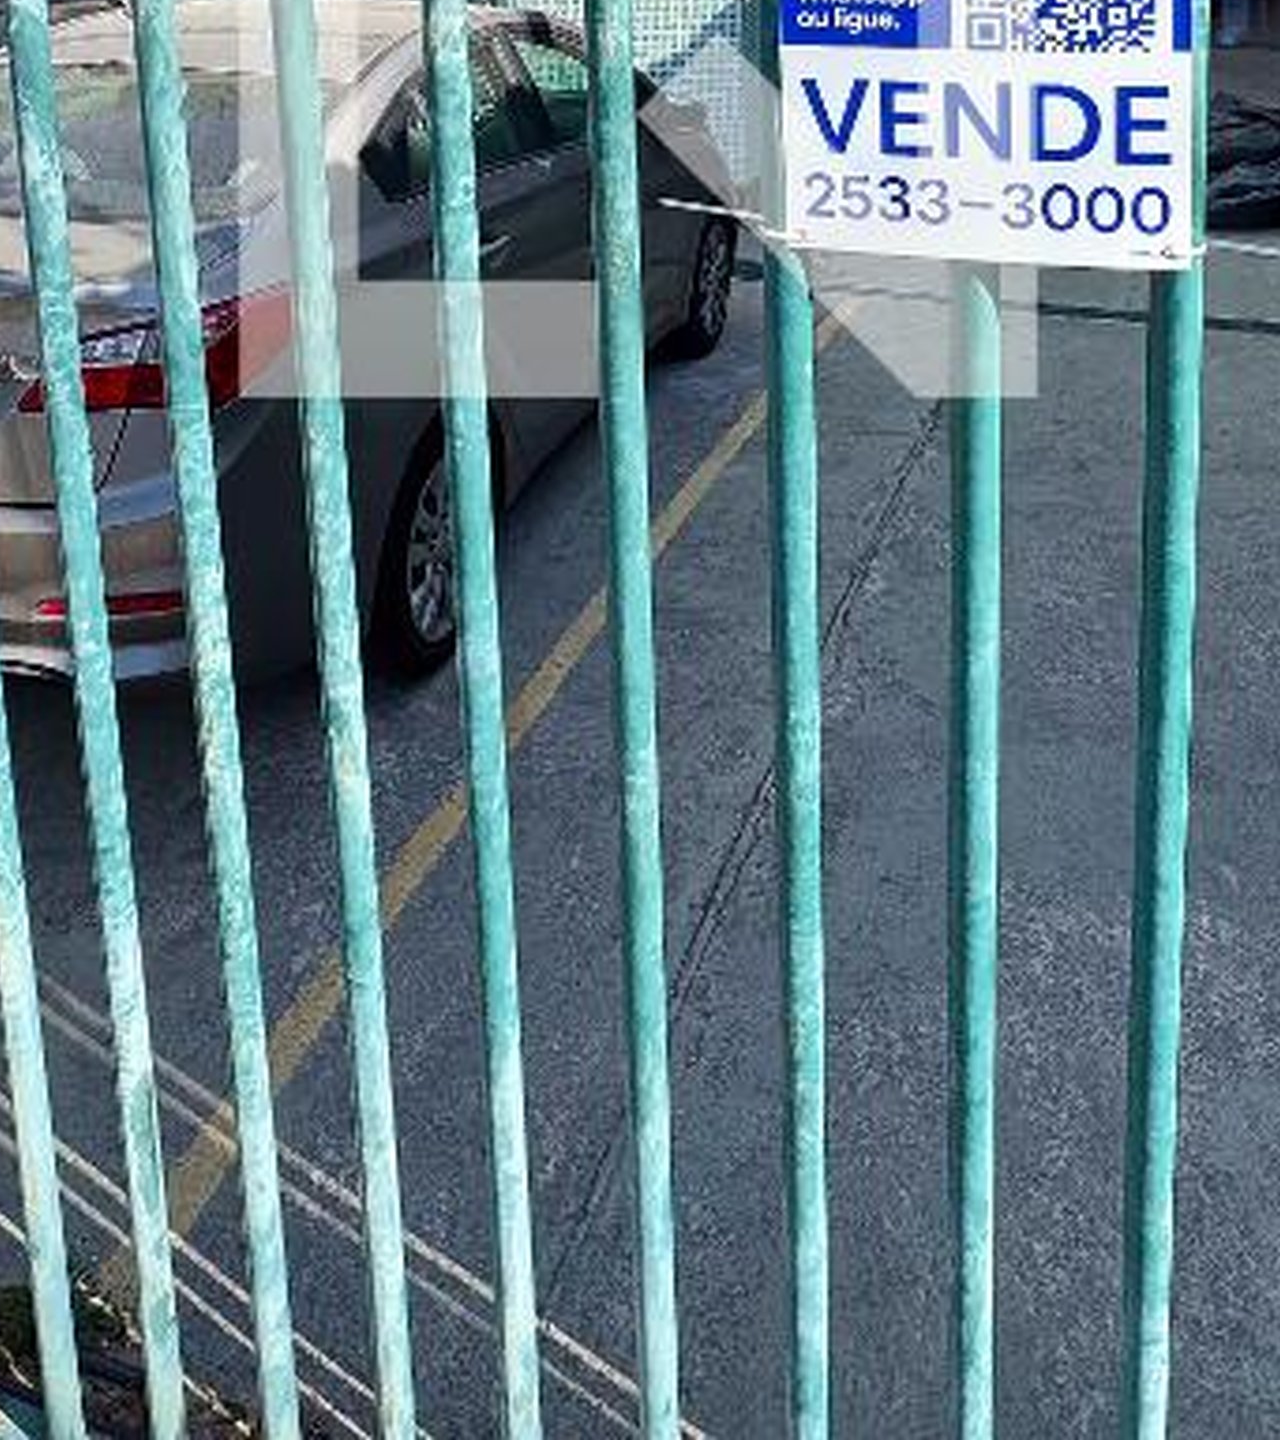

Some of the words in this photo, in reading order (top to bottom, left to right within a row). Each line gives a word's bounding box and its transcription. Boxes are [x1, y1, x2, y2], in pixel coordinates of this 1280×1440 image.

[796, 10, 829, 28] ou
[834, 7, 901, 35] ligue.
[801, 78, 1173, 166] VENDE
[804, 171, 1173, 235] 2533-3000
